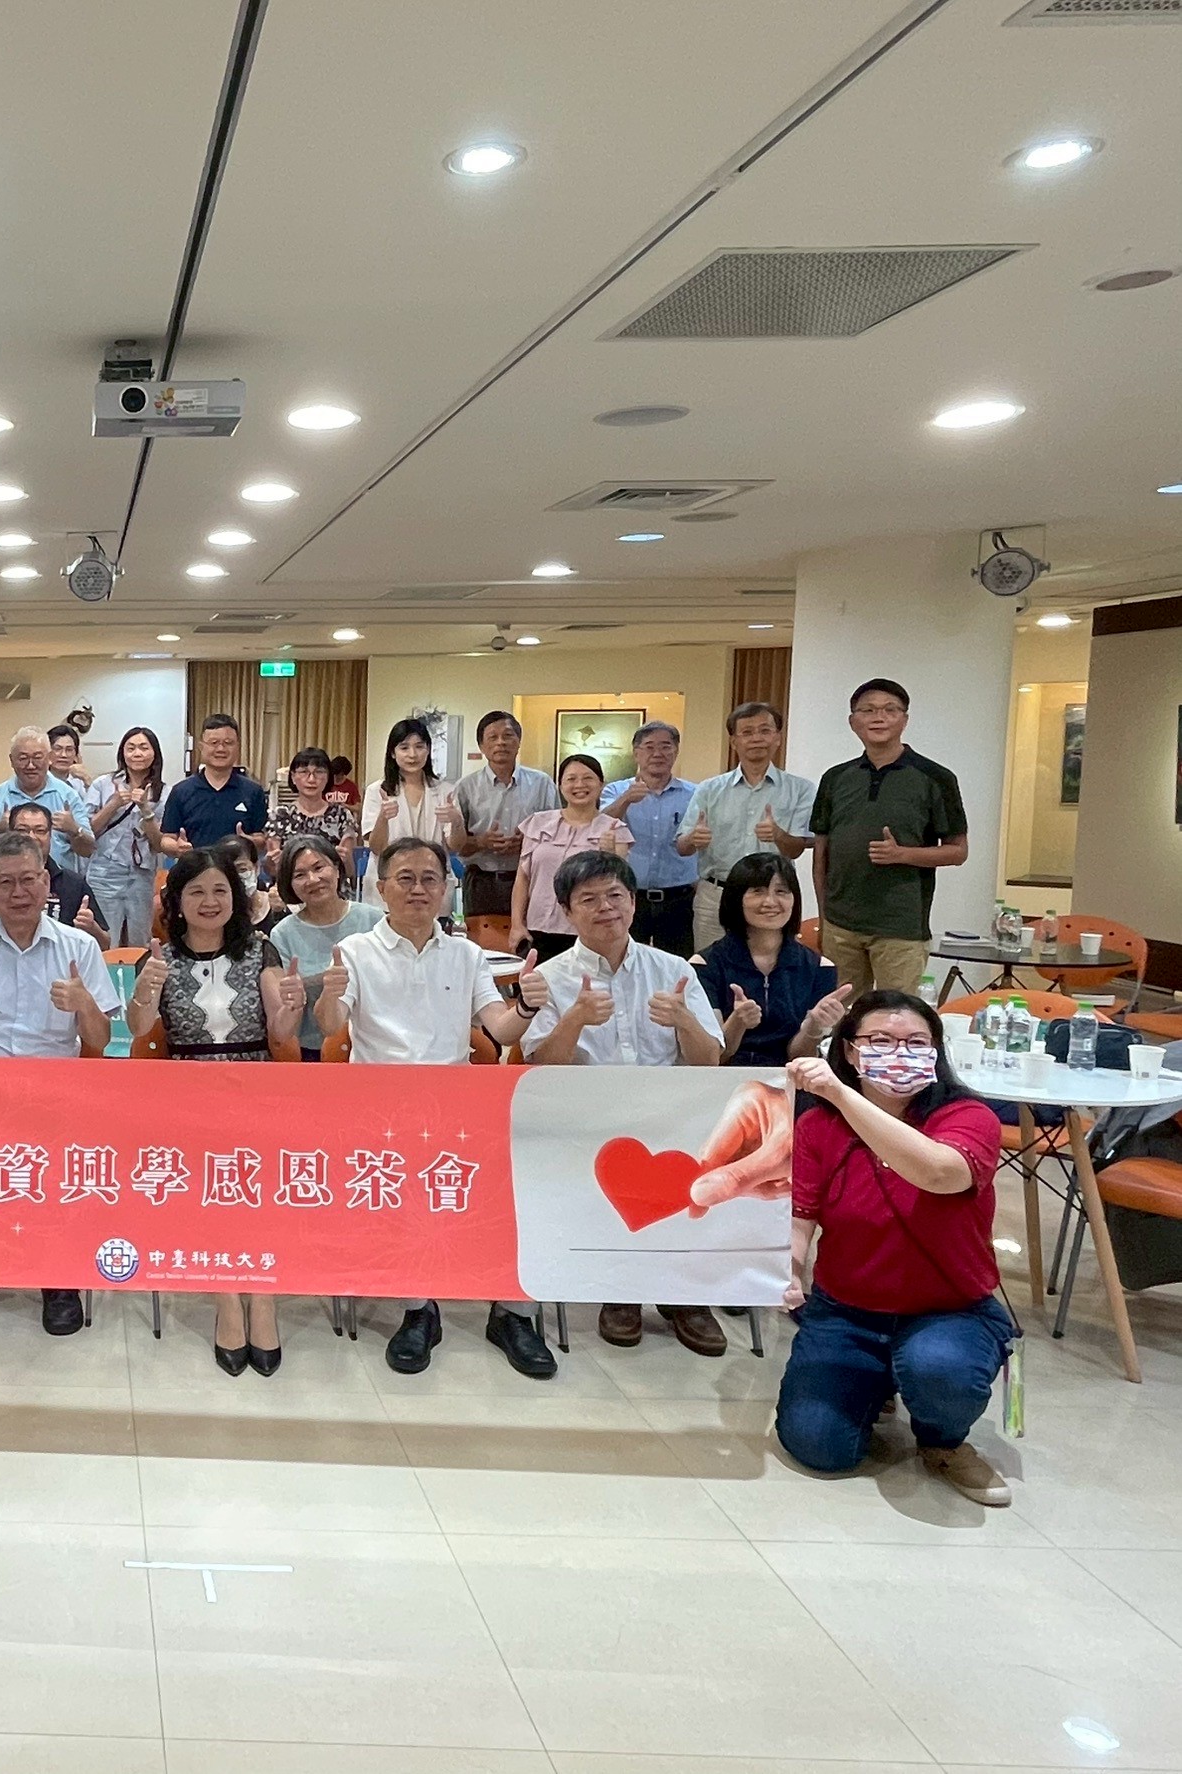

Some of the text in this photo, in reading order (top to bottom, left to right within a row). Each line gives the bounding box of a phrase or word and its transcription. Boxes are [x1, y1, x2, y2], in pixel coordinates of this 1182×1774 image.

[148, 1249, 276, 1270] 中臺科技大學
